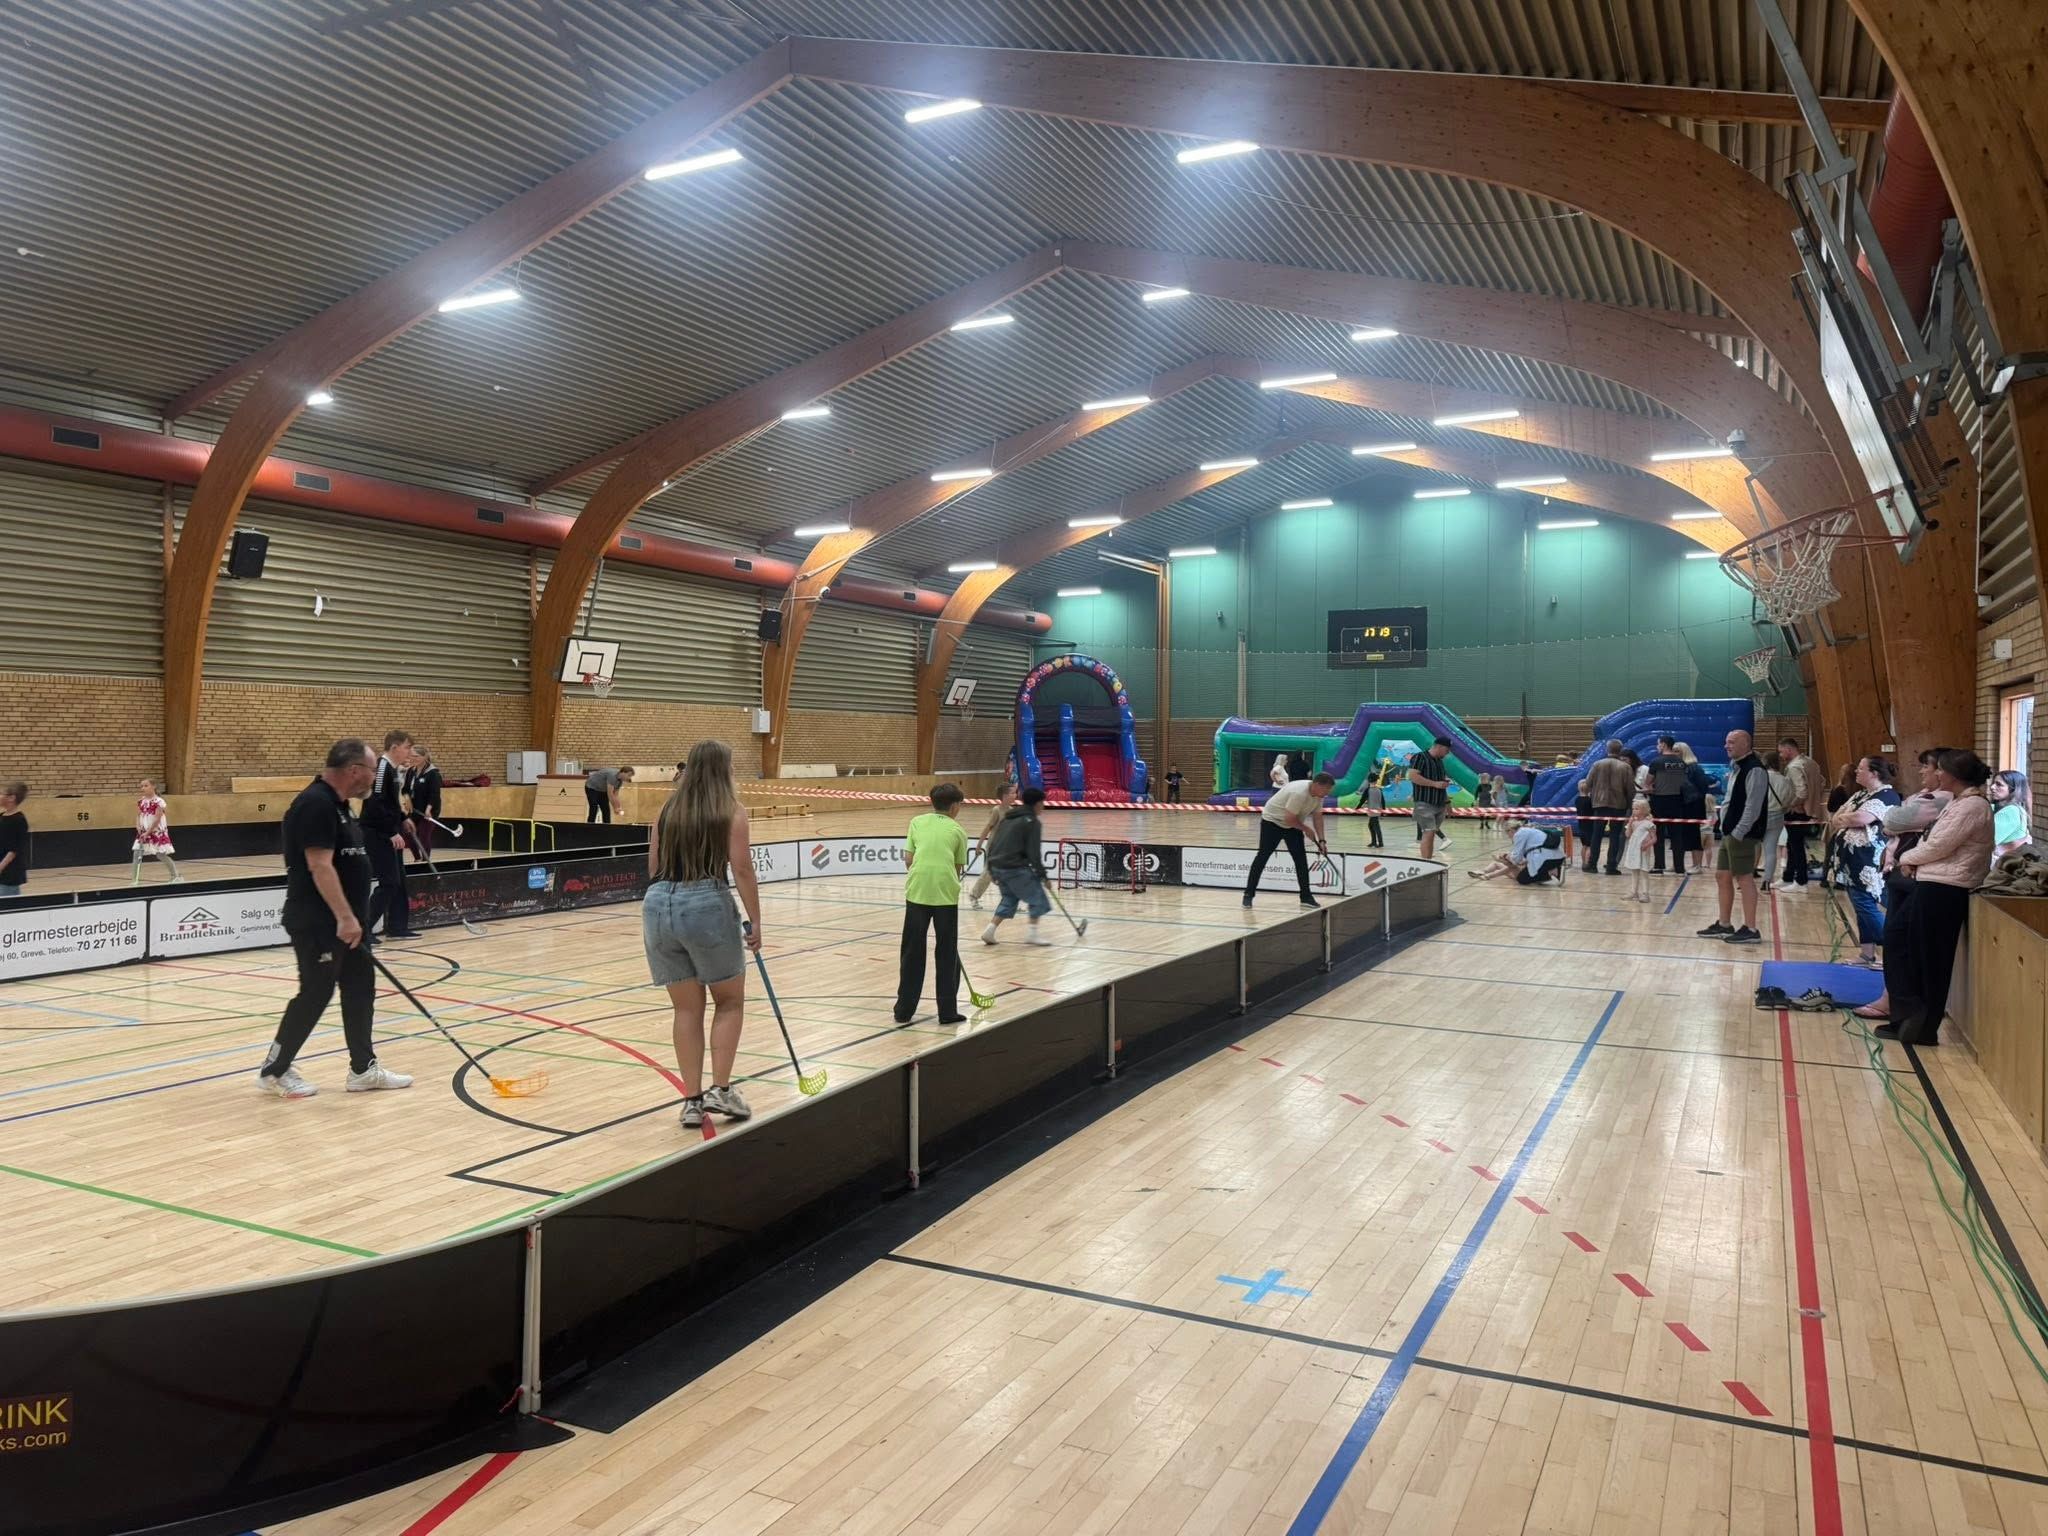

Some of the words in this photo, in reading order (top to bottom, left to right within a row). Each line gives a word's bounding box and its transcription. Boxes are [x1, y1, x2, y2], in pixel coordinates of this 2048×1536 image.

[257, 803, 267, 812] 57
[76, 812, 90, 822] 56
[240, 909, 262, 920] Salg
[263, 908, 275, 918] og
[2, 917, 138, 949] glarmesterarbejde
[159, 925, 236, 942] Brandteknik
[77, 941, 91, 952] 70
[93, 938, 107, 950] 27
[110, 937, 121, 948] 11
[124, 934, 138, 946] 66
[0, 1397, 68, 1430] INK
